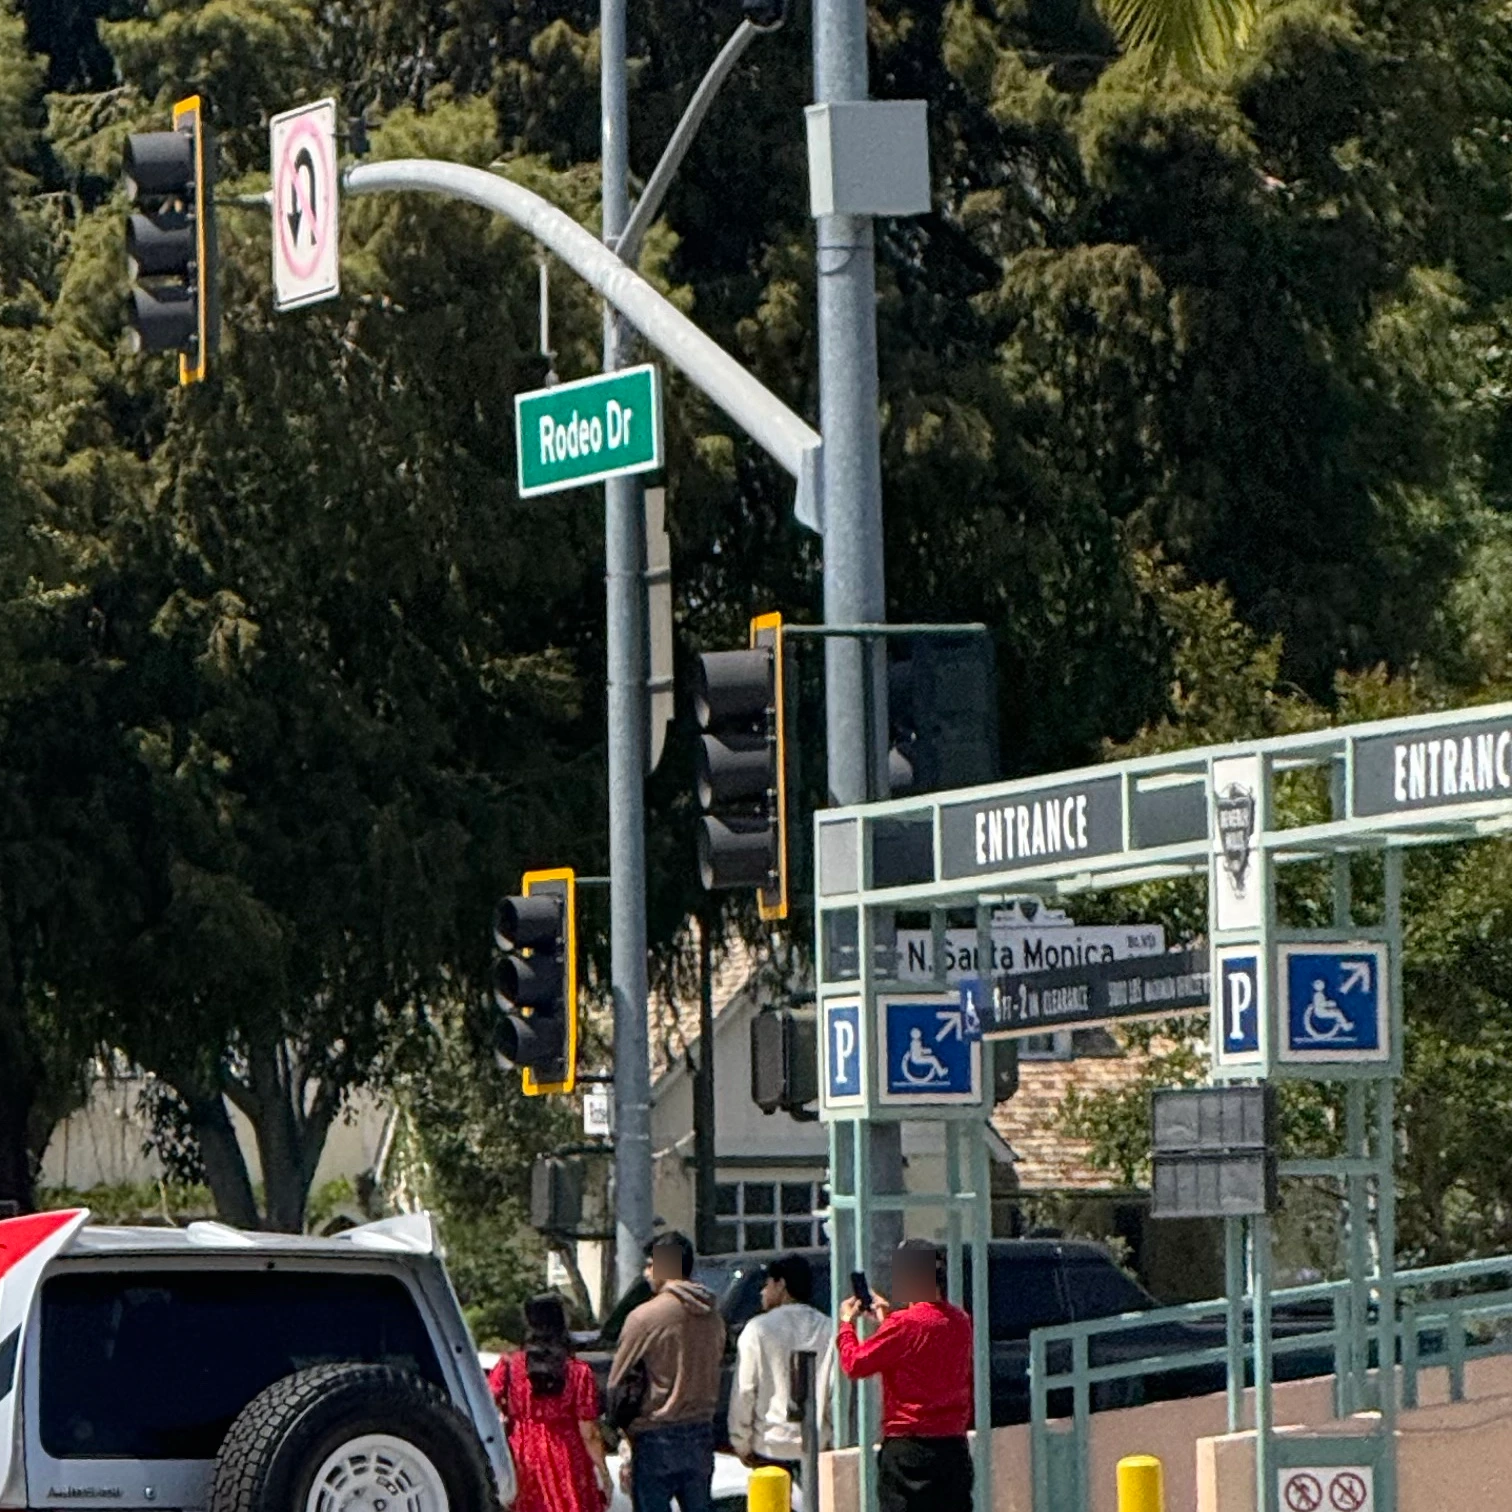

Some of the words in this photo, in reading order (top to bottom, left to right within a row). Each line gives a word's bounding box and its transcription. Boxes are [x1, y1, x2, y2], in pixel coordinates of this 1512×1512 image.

[539, 410, 602, 465] Rodeo
[606, 399, 632, 449] Dr
[1394, 730, 1511, 802] ENTRANC
[975, 794, 1088, 865] ENTRANCE
[1023, 936, 1115, 969] Monica
[1227, 972, 1251, 1040] P
[833, 1020, 854, 1084] P
